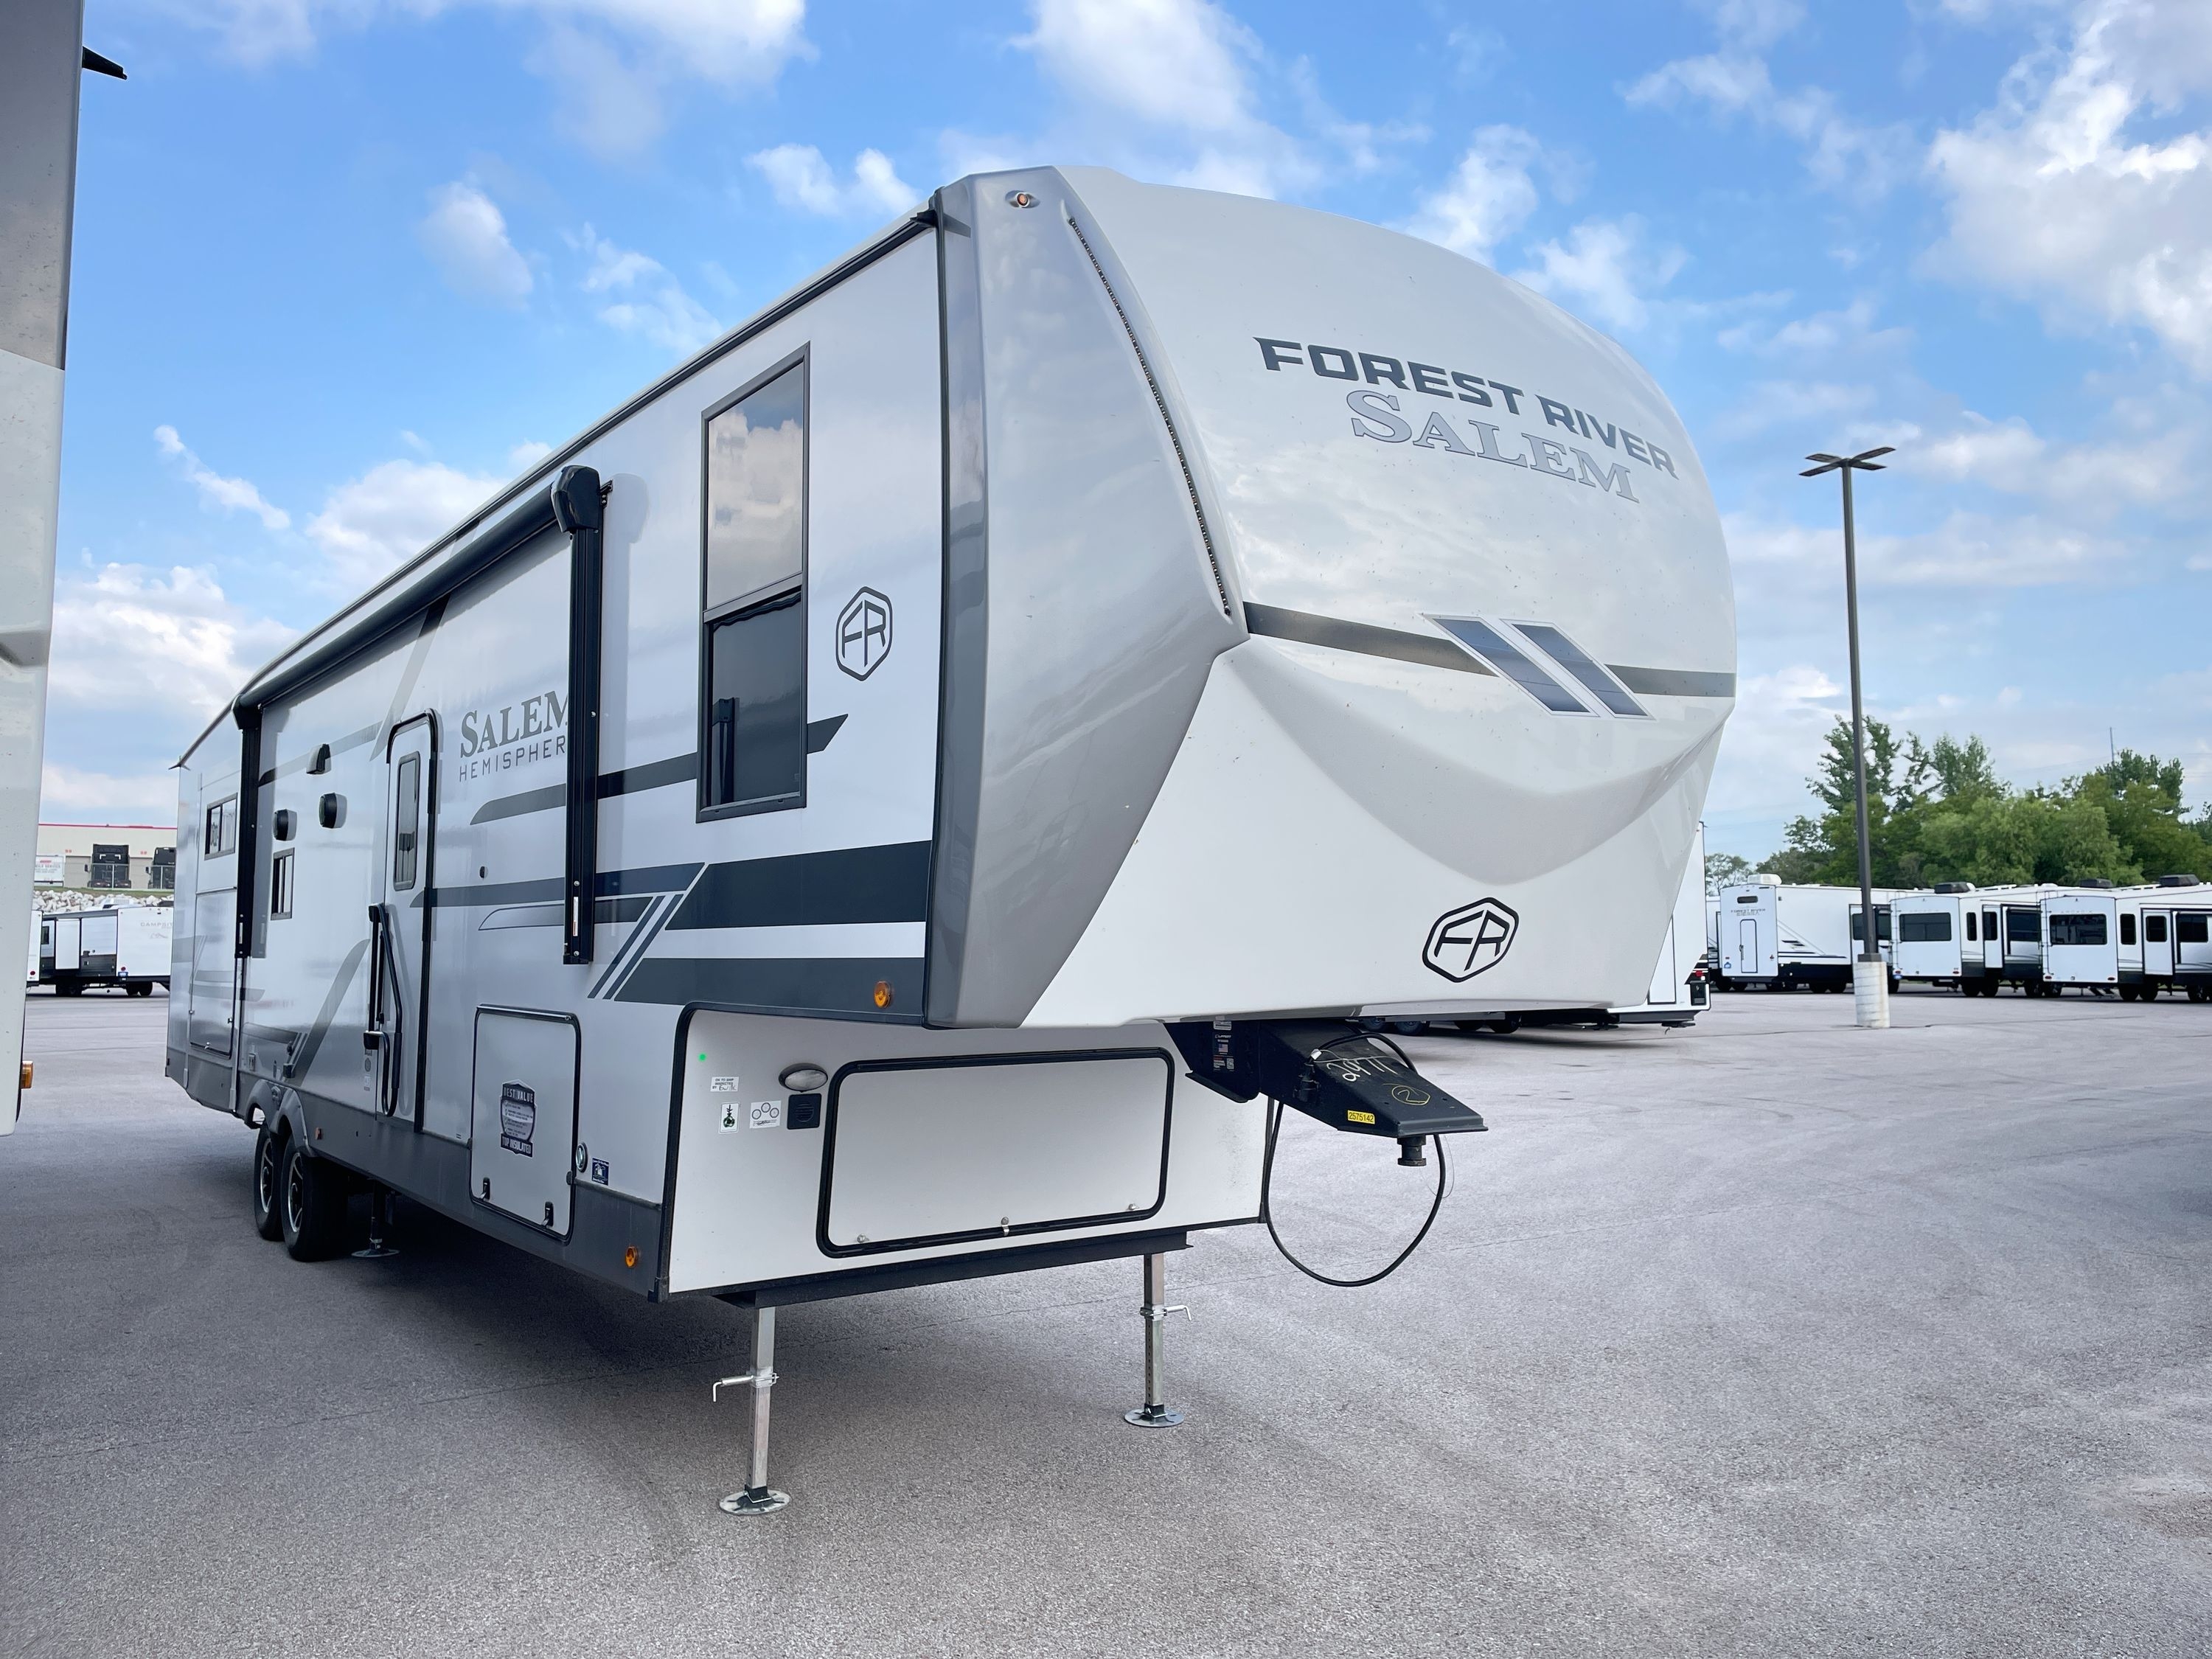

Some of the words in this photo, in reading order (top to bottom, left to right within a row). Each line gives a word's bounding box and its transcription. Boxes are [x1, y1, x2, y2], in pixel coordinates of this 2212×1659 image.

[1253, 337, 1524, 415] FOREST
[1535, 394, 1679, 479] RIVER
[1346, 390, 1639, 504] SALEM
[460, 690, 568, 759] SALEM
[459, 735, 566, 782] HEMISPHER
[517, 1091, 533, 1103] VALUE
[1349, 1111, 1374, 1123] 2575142
